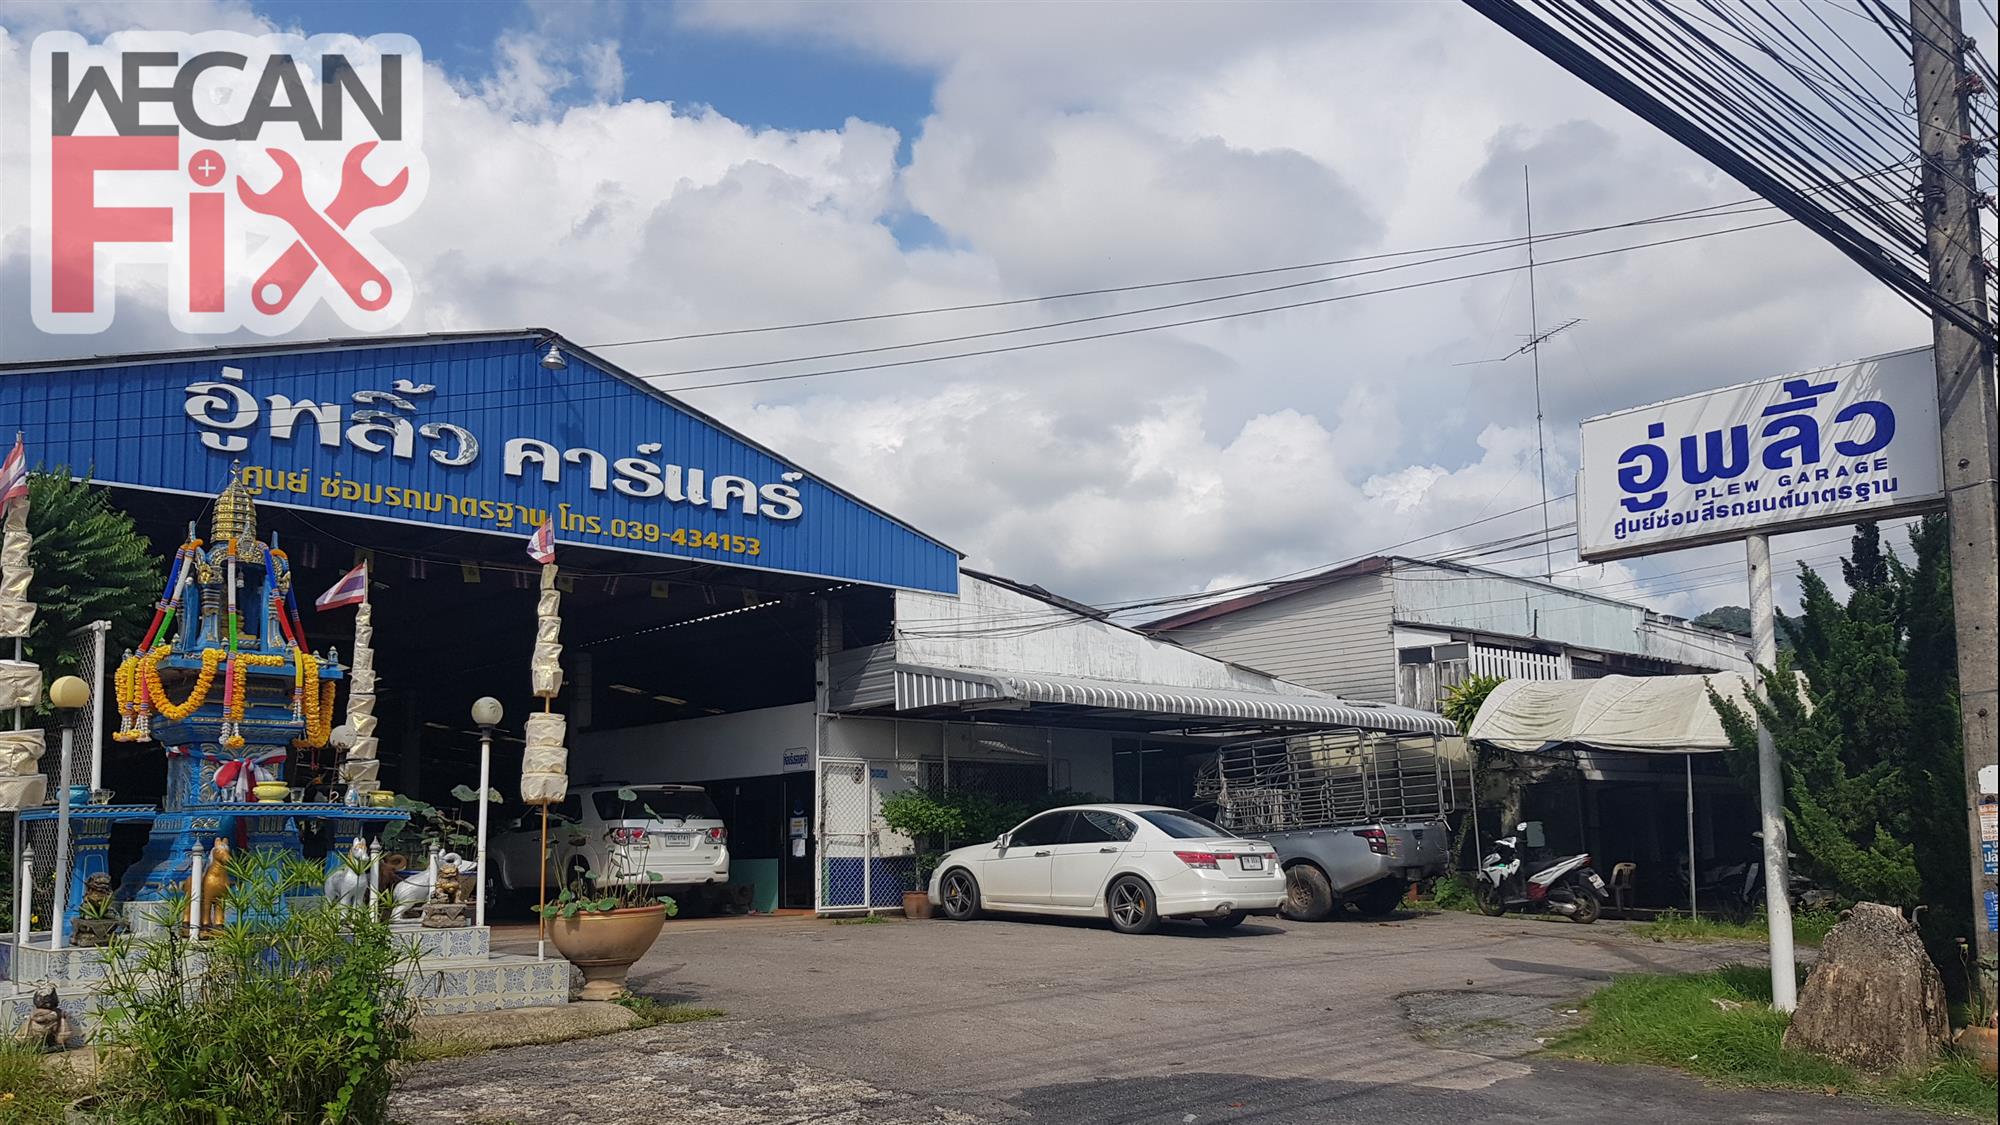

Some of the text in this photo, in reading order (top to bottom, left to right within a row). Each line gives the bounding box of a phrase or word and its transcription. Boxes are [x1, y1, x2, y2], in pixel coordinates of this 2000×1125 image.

[184, 366, 804, 520] อู่พลิ้ว คาร์แคร์
[1617, 378, 1896, 513] อู่พลิ้ว
[241, 465, 311, 496] ศูนย์
[1614, 477, 1898, 540] ศูนย์ซ่อมสีรถยนต์มาตรฐาน
[1694, 457, 1888, 501] PLEW GARAGE
